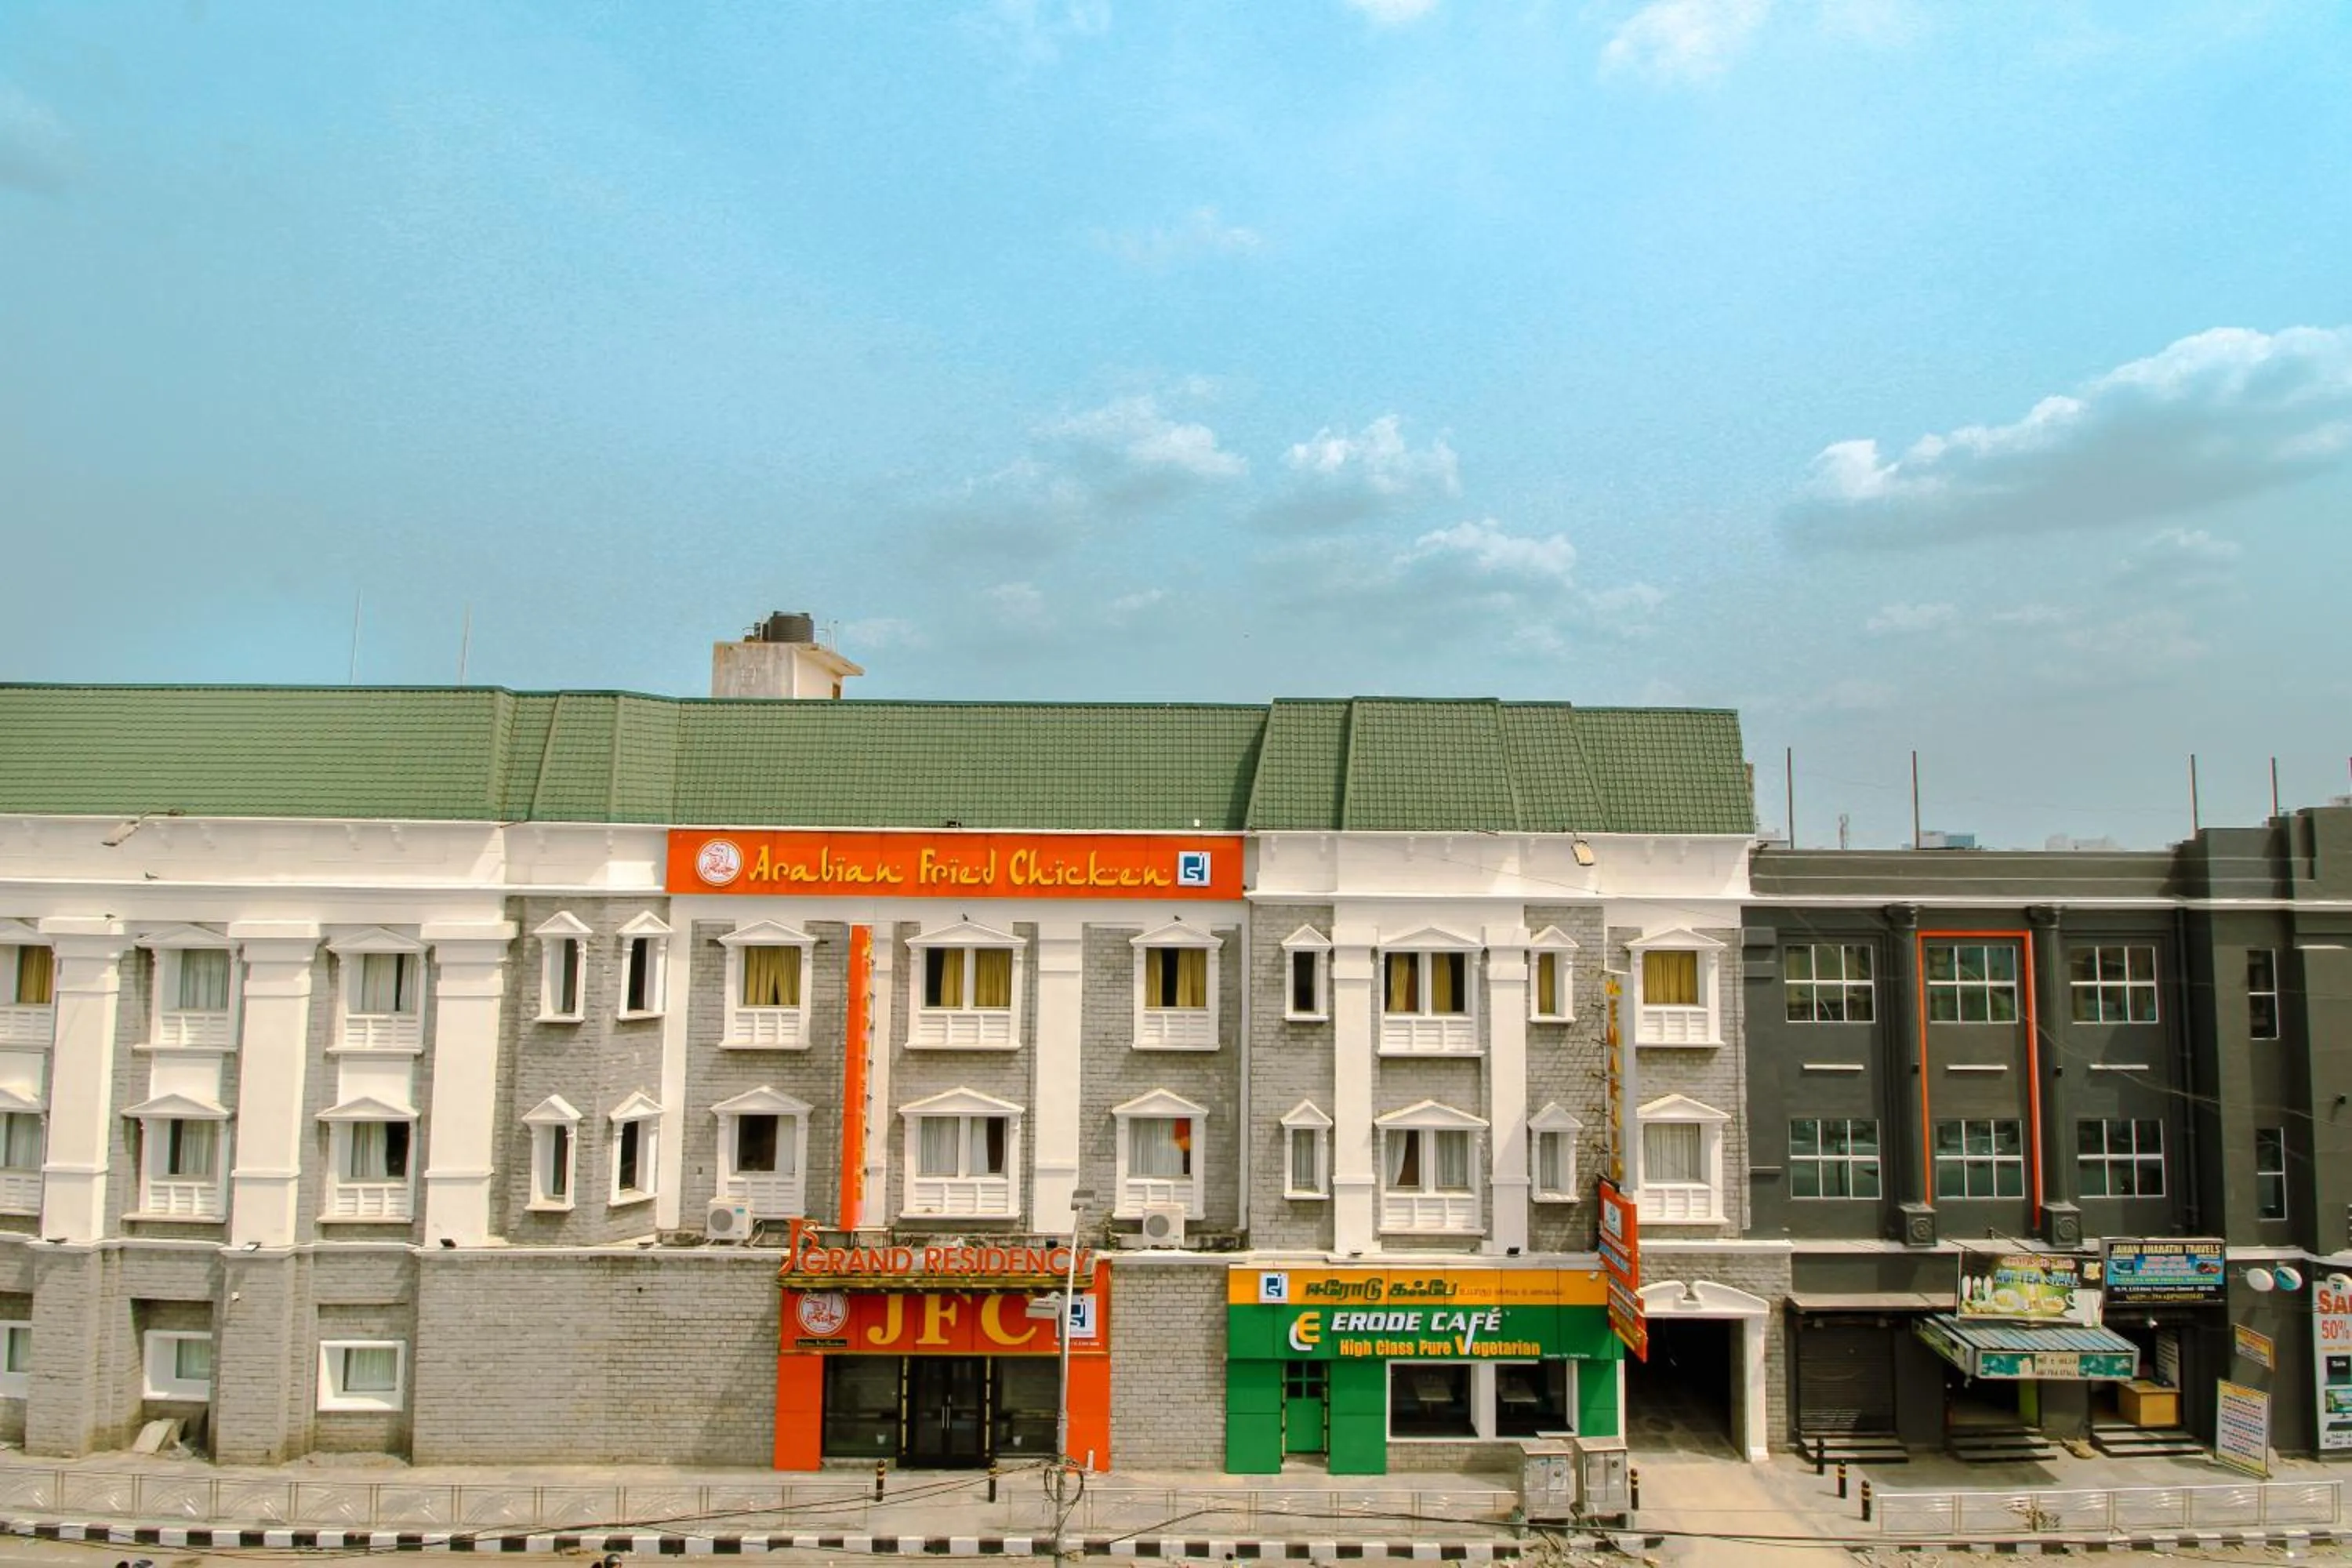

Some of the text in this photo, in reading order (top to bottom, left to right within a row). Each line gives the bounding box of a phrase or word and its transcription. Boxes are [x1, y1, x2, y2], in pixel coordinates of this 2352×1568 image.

[748, 845, 1171, 887] Arabian Fried Chicken
[800, 1247, 1091, 1274] GRAND RESIDENCY
[2185, 1244, 2221, 1254] TRAVELS
[1331, 1312, 1423, 1331] ERODE
[1340, 1334, 1541, 1357] High Class Pure Vegetarian
